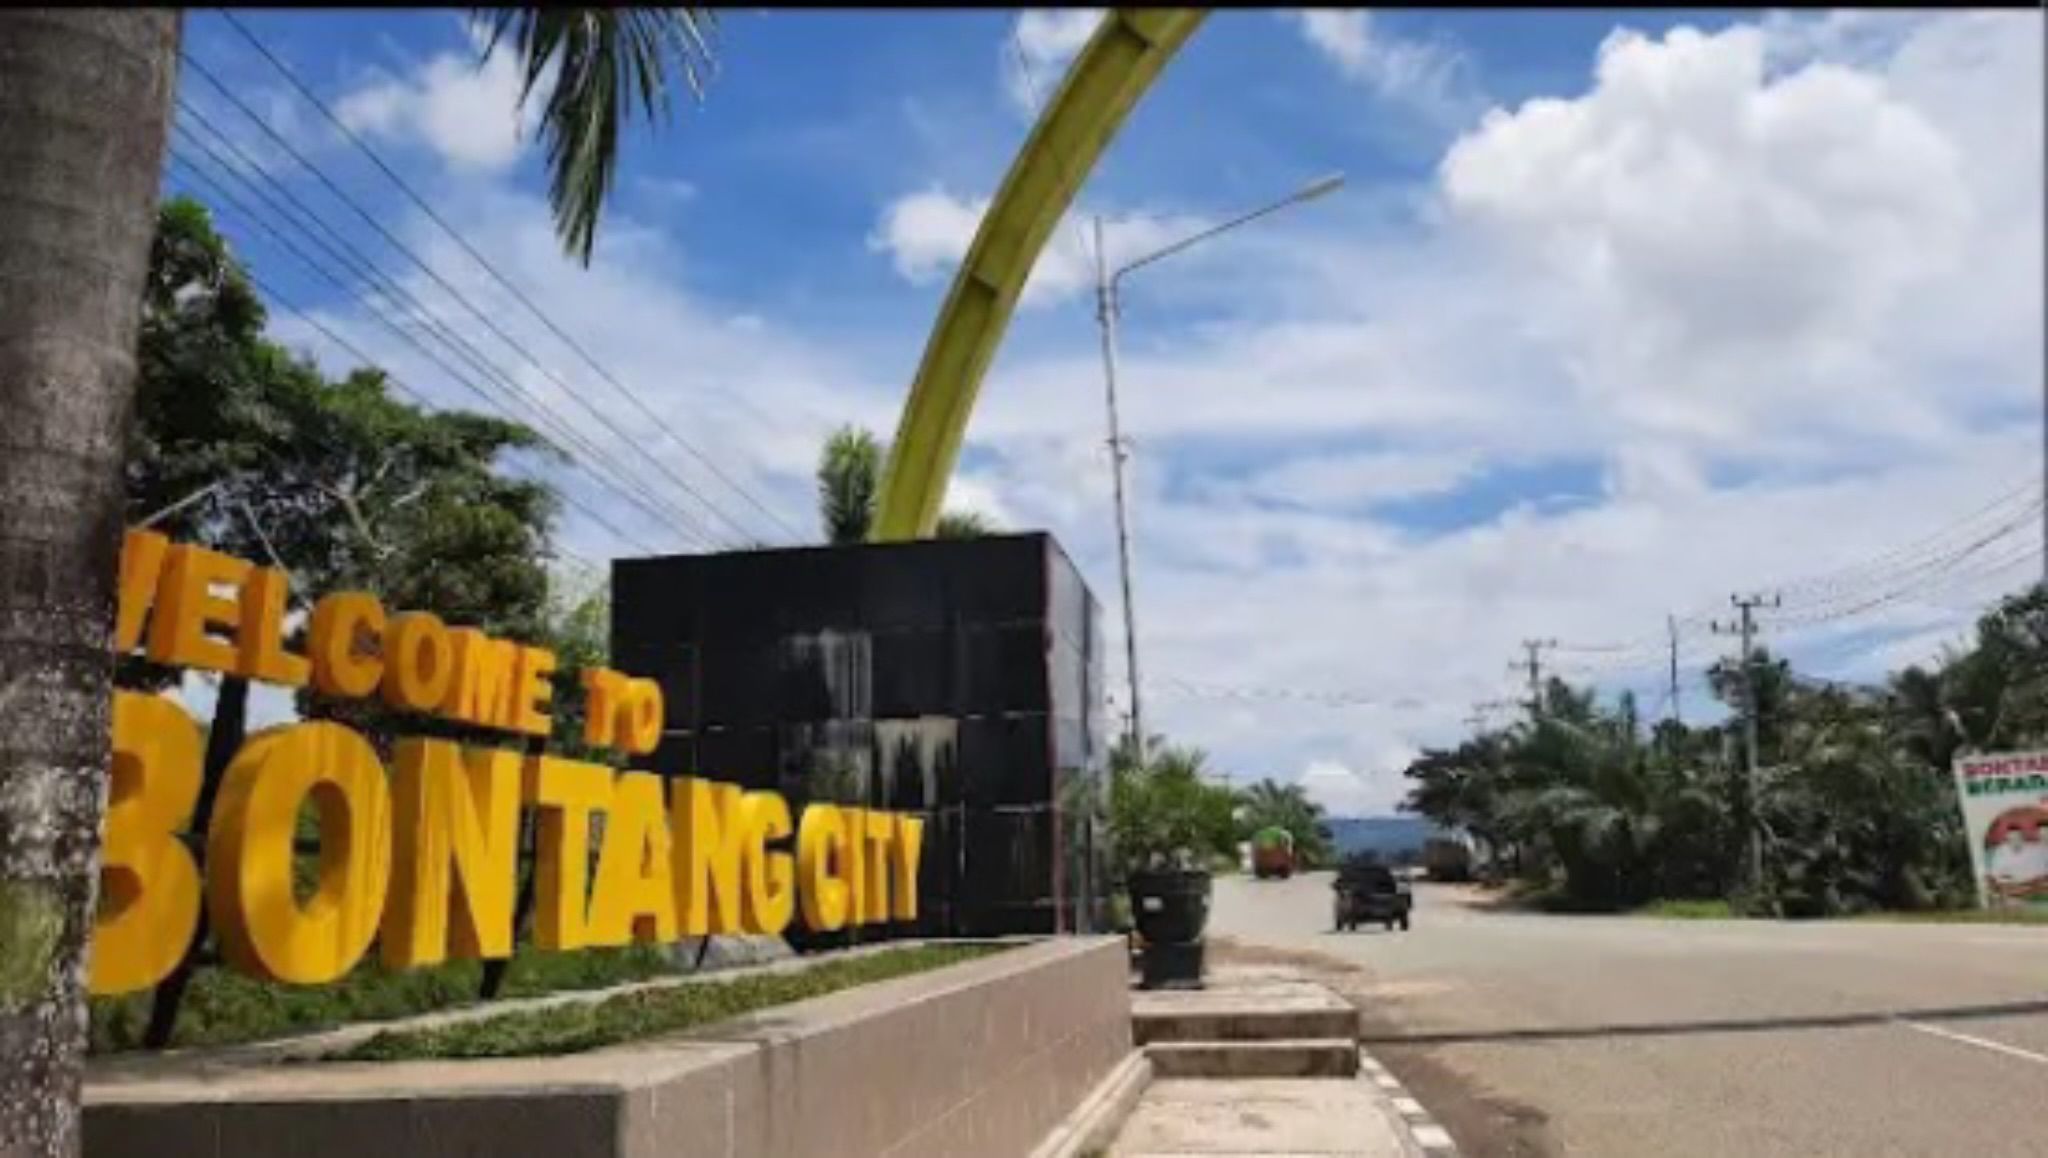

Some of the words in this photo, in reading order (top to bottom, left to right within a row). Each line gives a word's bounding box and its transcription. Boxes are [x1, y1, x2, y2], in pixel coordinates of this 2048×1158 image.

[583, 667, 664, 755] TO
[88, 690, 798, 994] BONTANG
[798, 802, 924, 932] CITY
